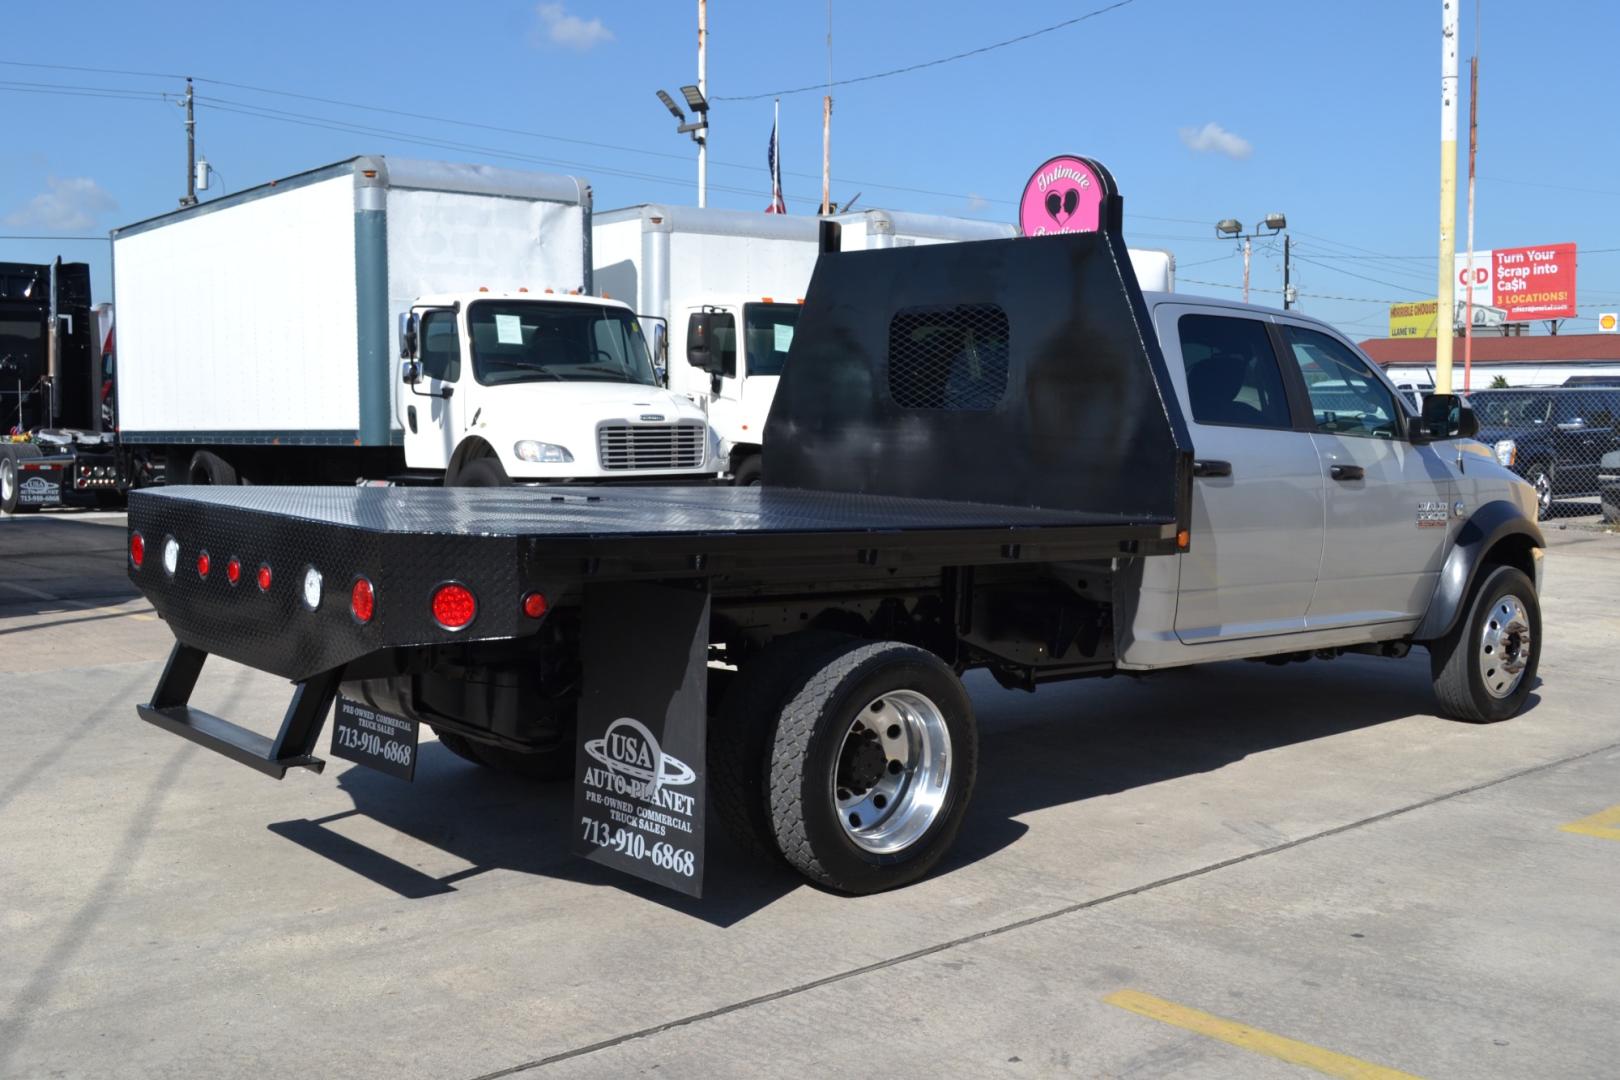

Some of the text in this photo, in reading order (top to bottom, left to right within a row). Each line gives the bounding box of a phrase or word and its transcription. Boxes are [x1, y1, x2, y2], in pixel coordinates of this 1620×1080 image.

[1037, 165, 1091, 193] Intimate
[1497, 250, 1555, 264] Turn Your
[1459, 268, 1489, 285] CD
[1497, 263, 1558, 279] $crap into
[1497, 278, 1527, 292] Ca$h
[1497, 292, 1568, 304] 3 LOCATIONS!
[358, 718, 394, 736] TRUCK SALES
[375, 714, 412, 732] COMMERCIAL
[338, 726, 412, 766] 713-910-6868
[611, 732, 652, 769] USA
[583, 766, 695, 817] AUTO-PLANET
[586, 790, 693, 833] PRE-OWNED COMMERCIAL
[610, 809, 666, 836] TRUCK SALES
[581, 816, 695, 877] 713-910-6868
